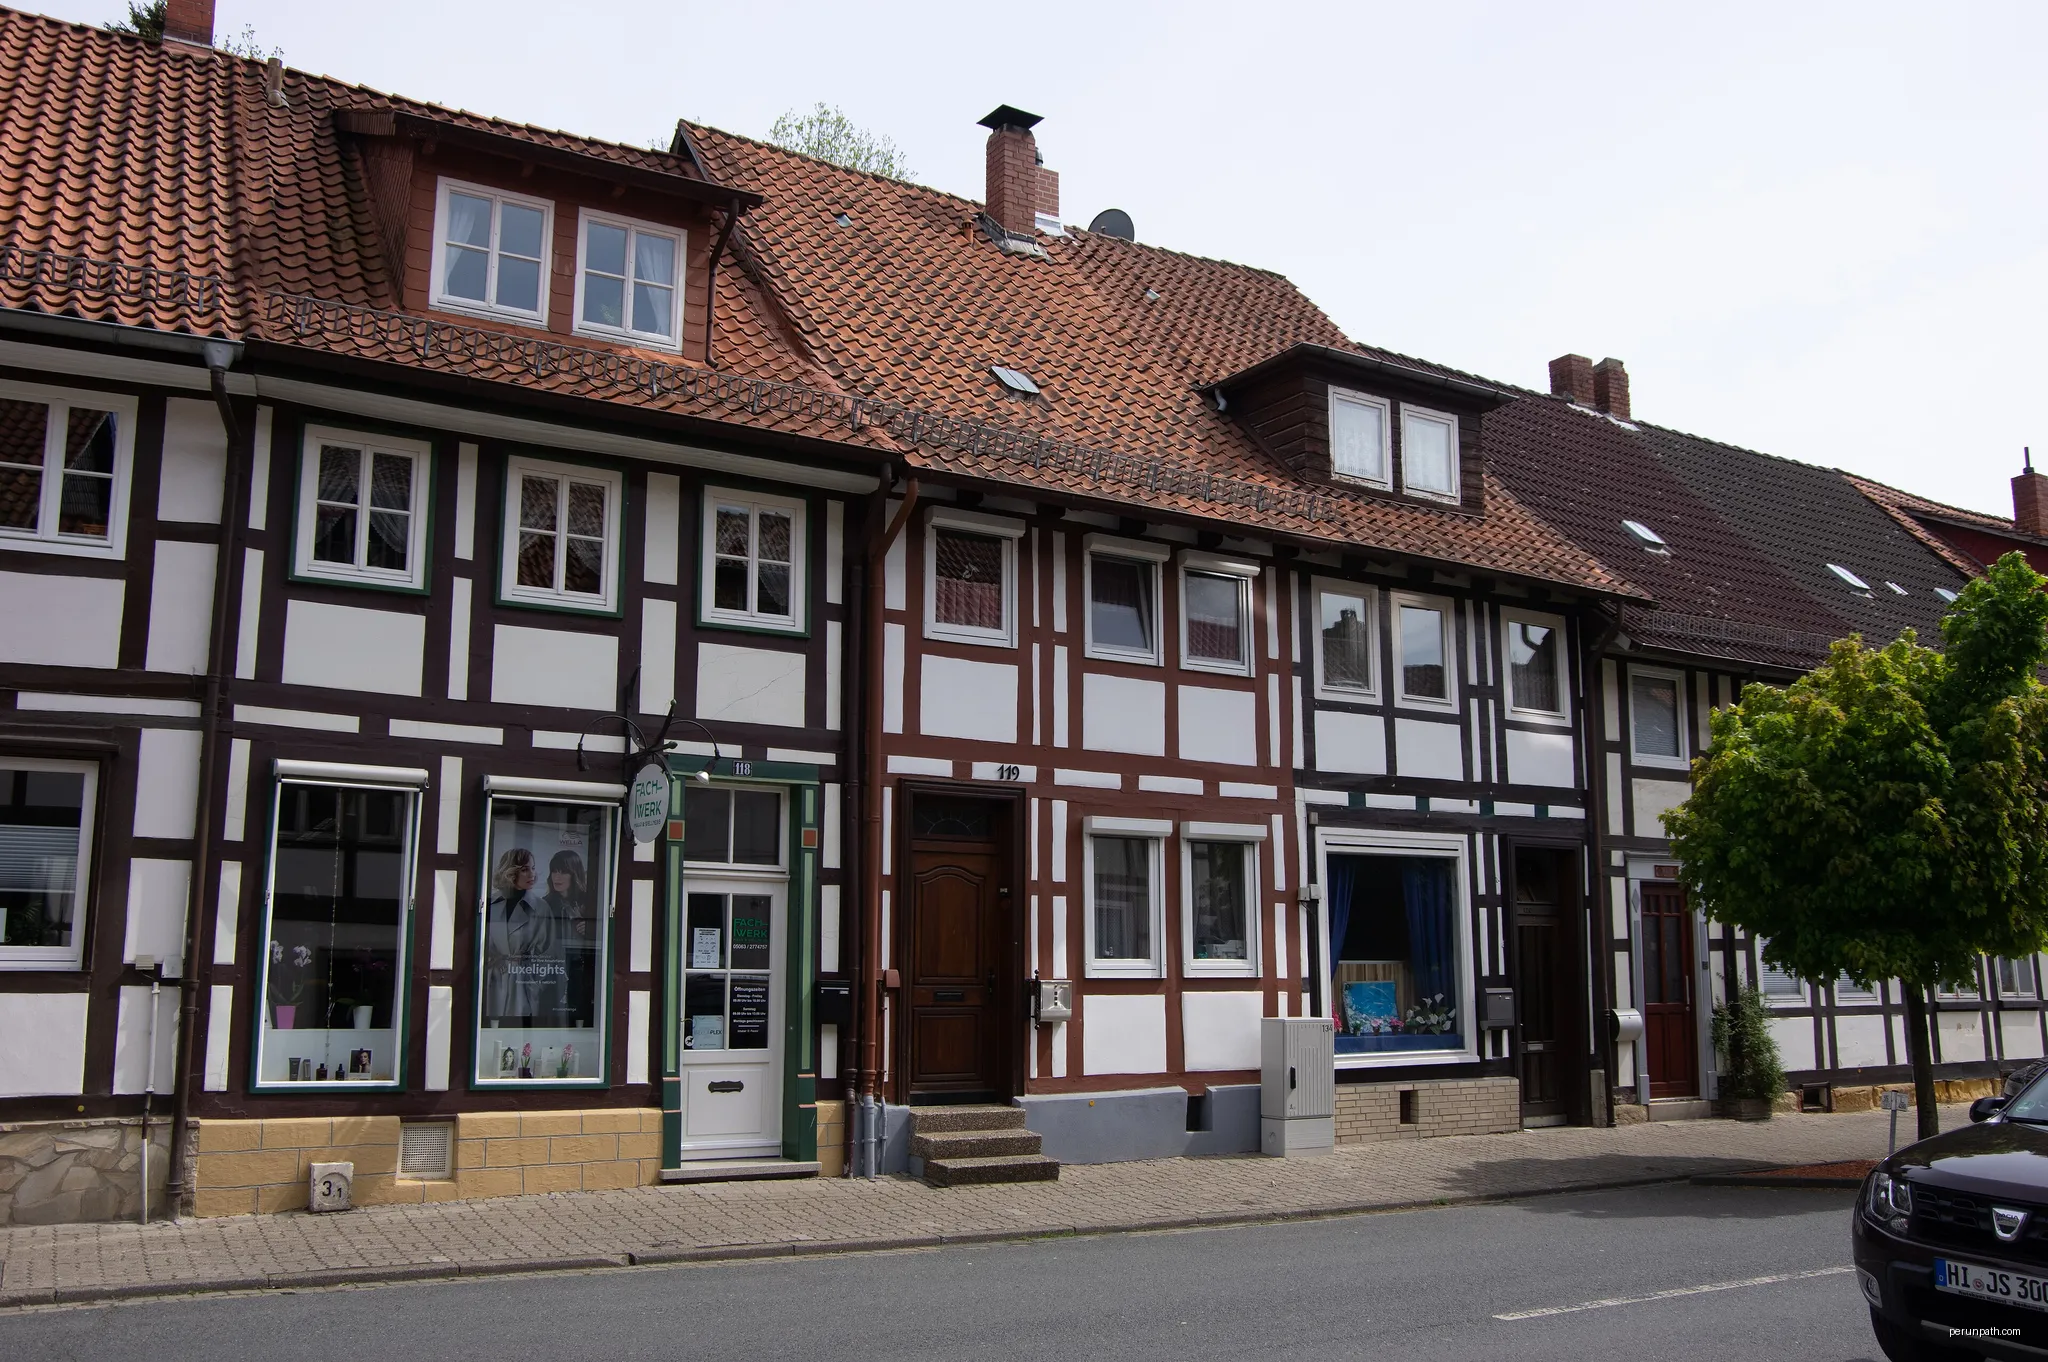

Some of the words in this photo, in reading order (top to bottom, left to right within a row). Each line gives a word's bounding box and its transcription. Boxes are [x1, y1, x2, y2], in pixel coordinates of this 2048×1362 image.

[735, 762, 751, 776] 118
[997, 764, 1020, 781] 119
[636, 800, 662, 818] WERK
[736, 929, 768, 937] WERK
[507, 963, 565, 977] luxelights
[1947, 1263, 1970, 1288] HI
[1987, 1271, 2011, 1296] JS
